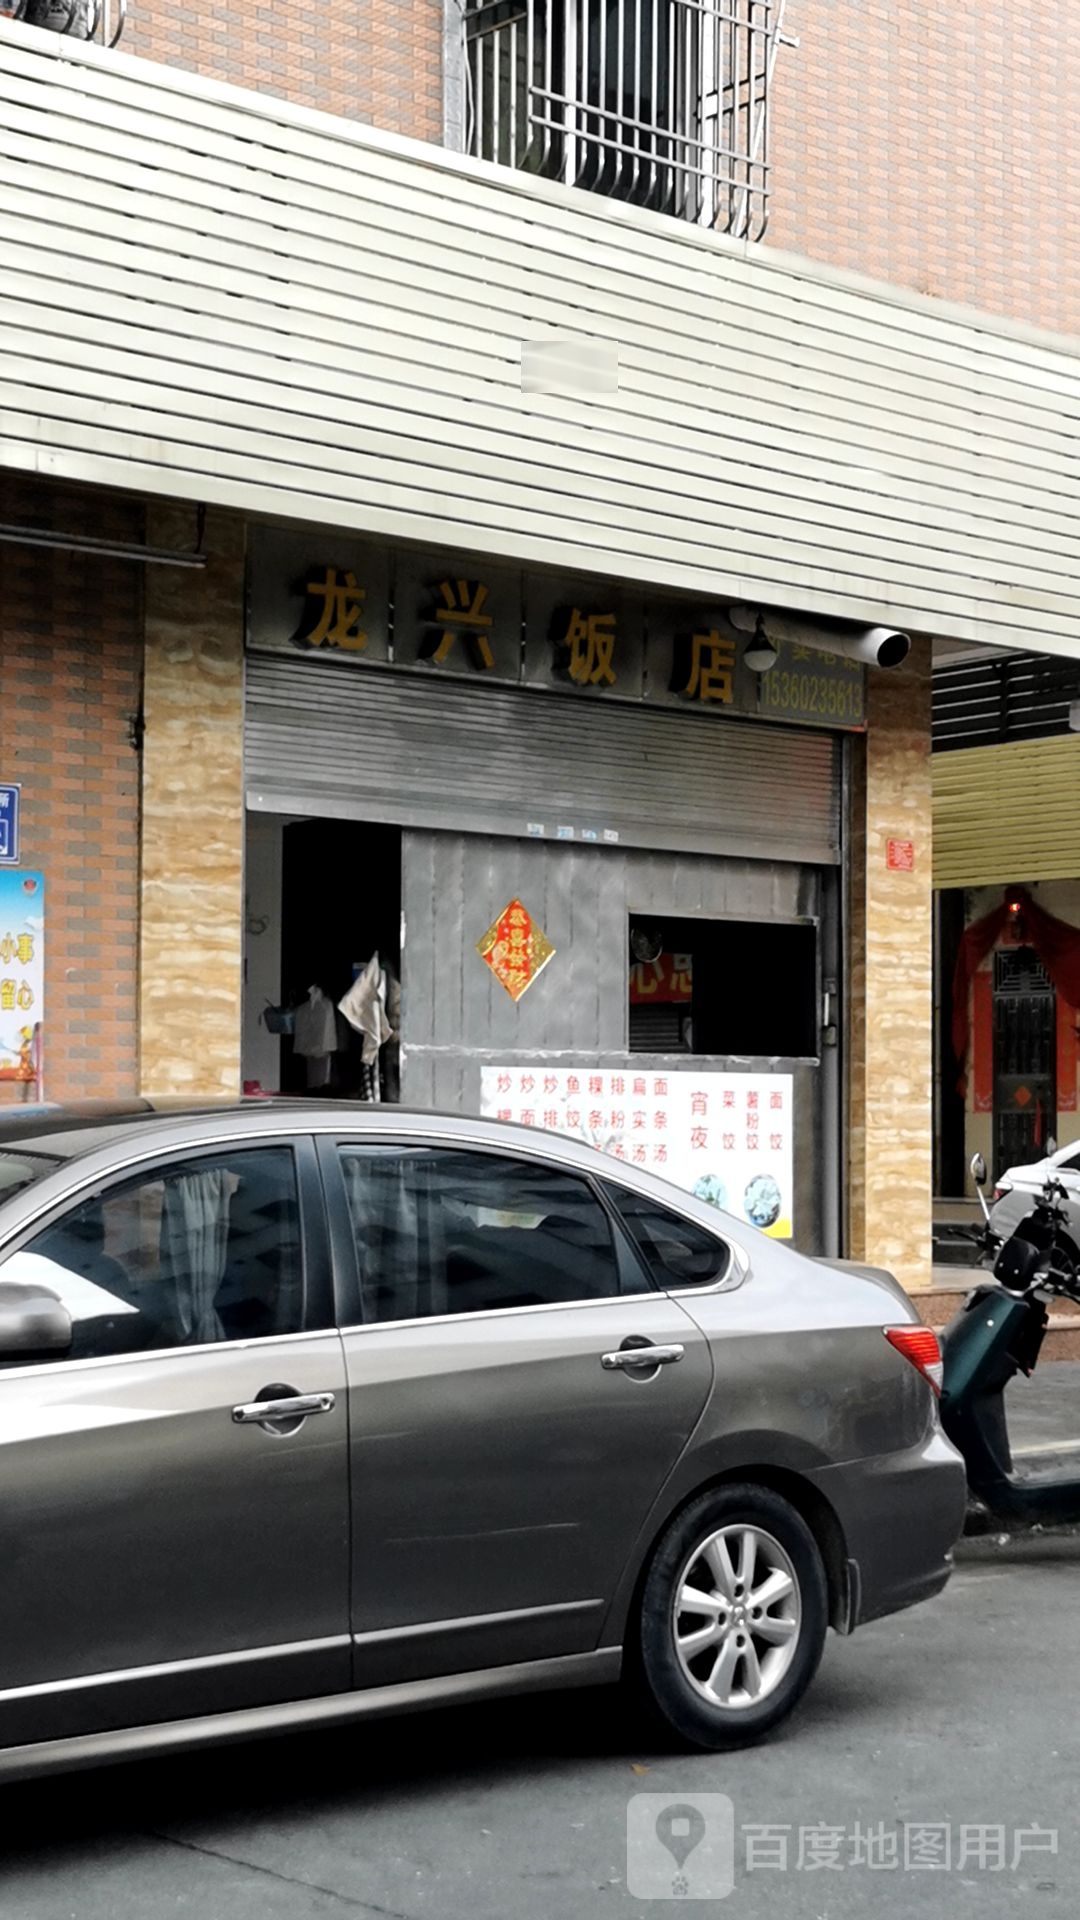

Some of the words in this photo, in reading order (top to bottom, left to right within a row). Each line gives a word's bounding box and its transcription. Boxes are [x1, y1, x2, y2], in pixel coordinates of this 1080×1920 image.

[303, 566, 738, 705] 龙兴饭店
[763, 671, 863, 718] 15360235613
[691, 1091, 709, 1150] 宵夜
